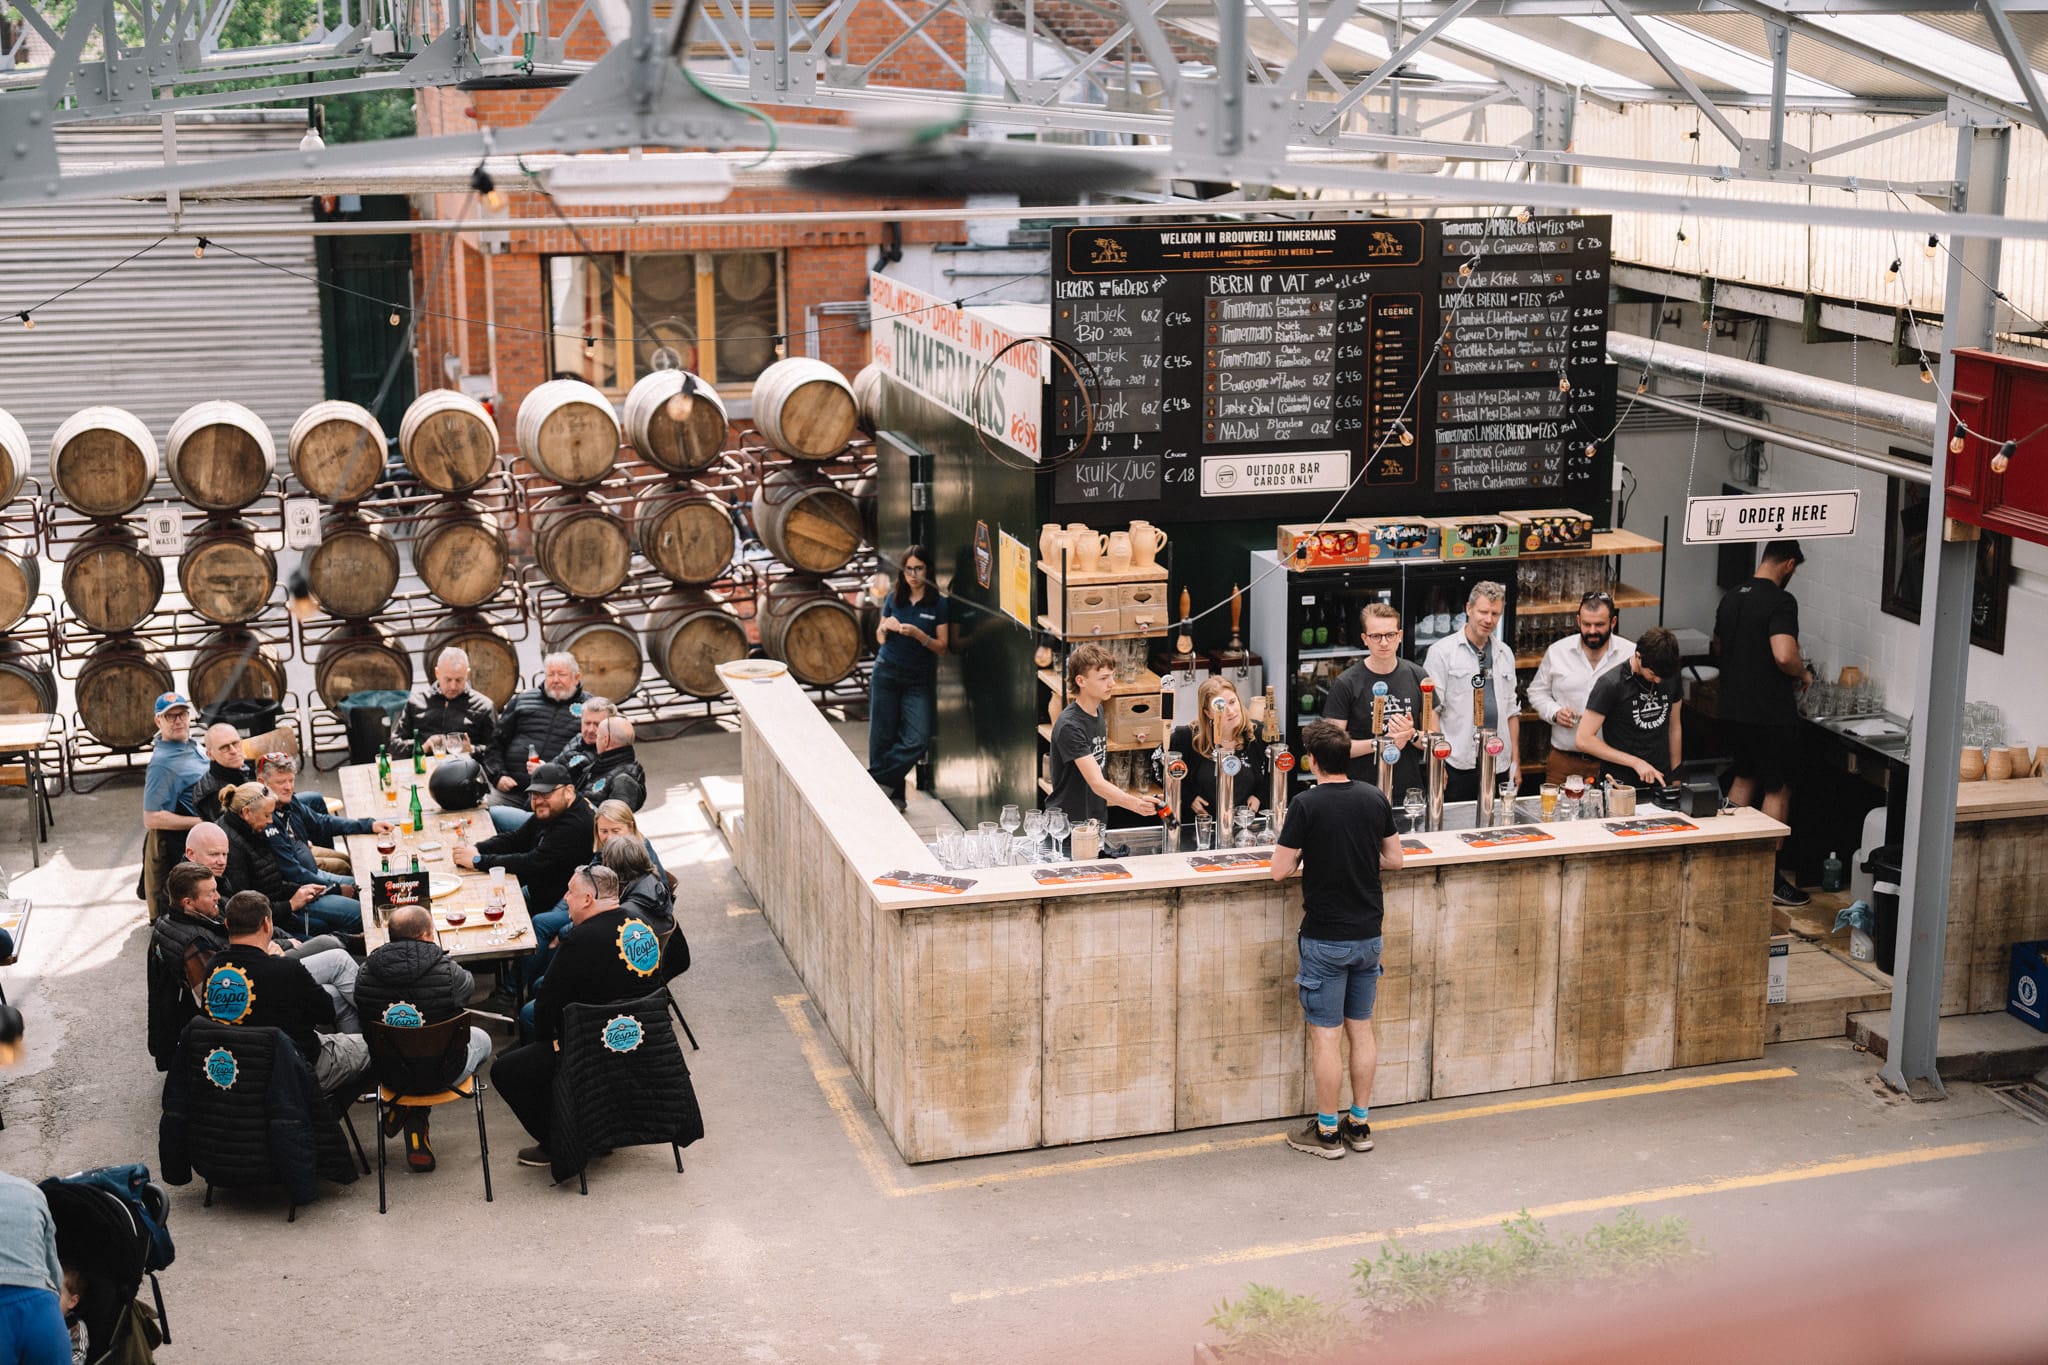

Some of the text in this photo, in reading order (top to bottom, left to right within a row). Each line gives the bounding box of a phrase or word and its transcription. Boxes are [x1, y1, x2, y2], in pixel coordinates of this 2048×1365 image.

[1161, 230, 1336, 244] WELKOM IN BROUWERIJ TIMMERMANS
[1494, 239, 1534, 253] Gueuze
[1261, 276, 1273, 293] OP
[1280, 274, 1309, 292] VAT
[1490, 272, 1519, 286] Kriek
[1056, 280, 1094, 299] LEKKERS
[1221, 298, 1273, 319] Timmermans
[1519, 293, 1542, 307] FLES
[1073, 303, 1127, 325] Lambiek
[1378, 307, 1414, 316] LEGENDE
[1220, 320, 1300, 344] Timmermans Kriek
[1218, 345, 1302, 368] Timmermans Oude
[893, 320, 1006, 436] TIMMERMANS
[1220, 372, 1269, 393] Bourgogne
[1219, 396, 1247, 418] Lambic
[1539, 422, 1557, 439] FLES
[1247, 462, 1320, 476] OUTDOOR BAR
[1254, 475, 1314, 487] CARDS ONLY
[1083, 487, 1099, 497] van
[1739, 505, 1828, 524] ORDER HERE
[1472, 549, 1491, 557] MAX
[625, 936, 656, 961] Vespa
[208, 988, 246, 1008] Vespa
[388, 1016, 419, 1026] Vespa
[607, 1029, 639, 1043] Vespa
[208, 1064, 234, 1075] Vespa
